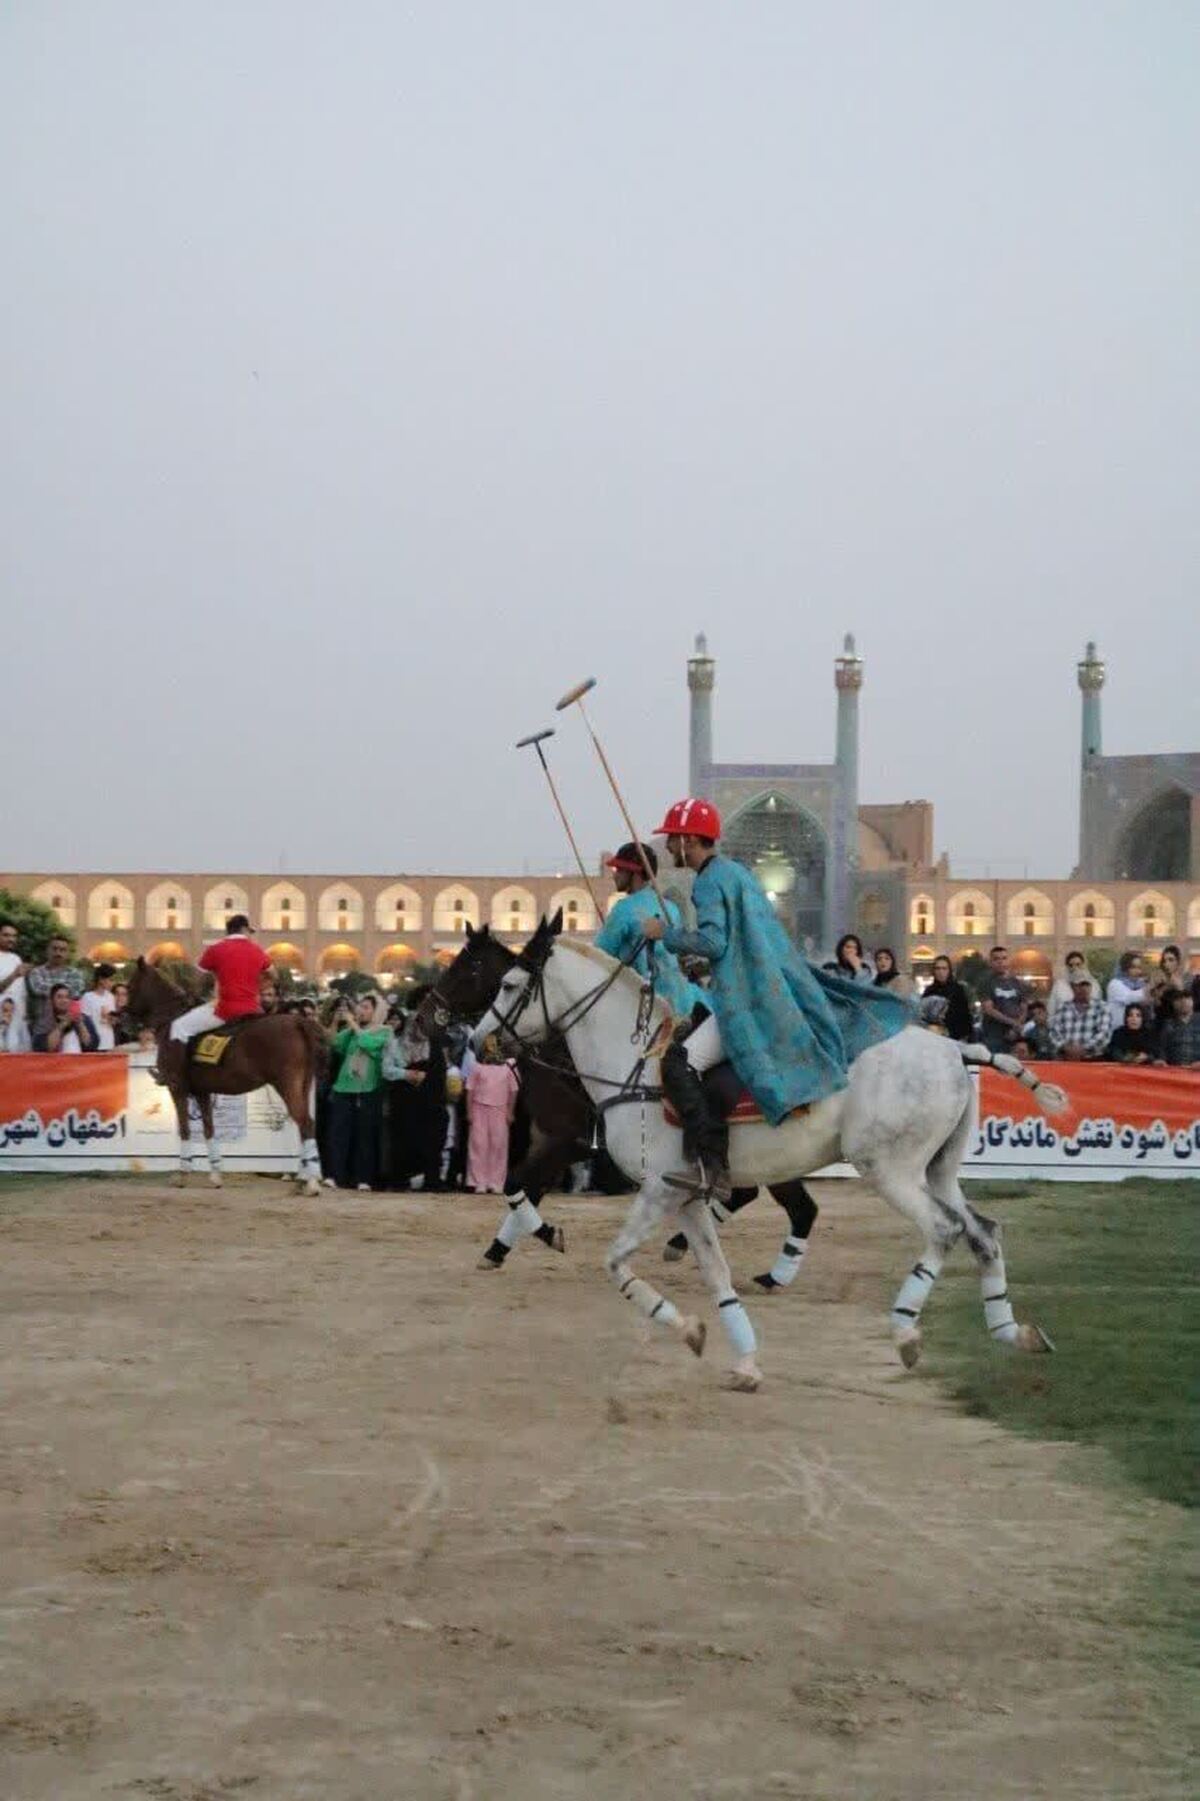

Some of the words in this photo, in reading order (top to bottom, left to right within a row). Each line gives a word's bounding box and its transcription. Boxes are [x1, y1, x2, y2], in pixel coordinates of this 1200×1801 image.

[0, 1113, 40, 1149] شهر
[48, 1113, 127, 1148] اصفهان
[974, 1120, 1056, 1156] ماندگار
[1063, 1122, 1113, 1157] نقش
[1120, 1125, 1166, 1159] شود
